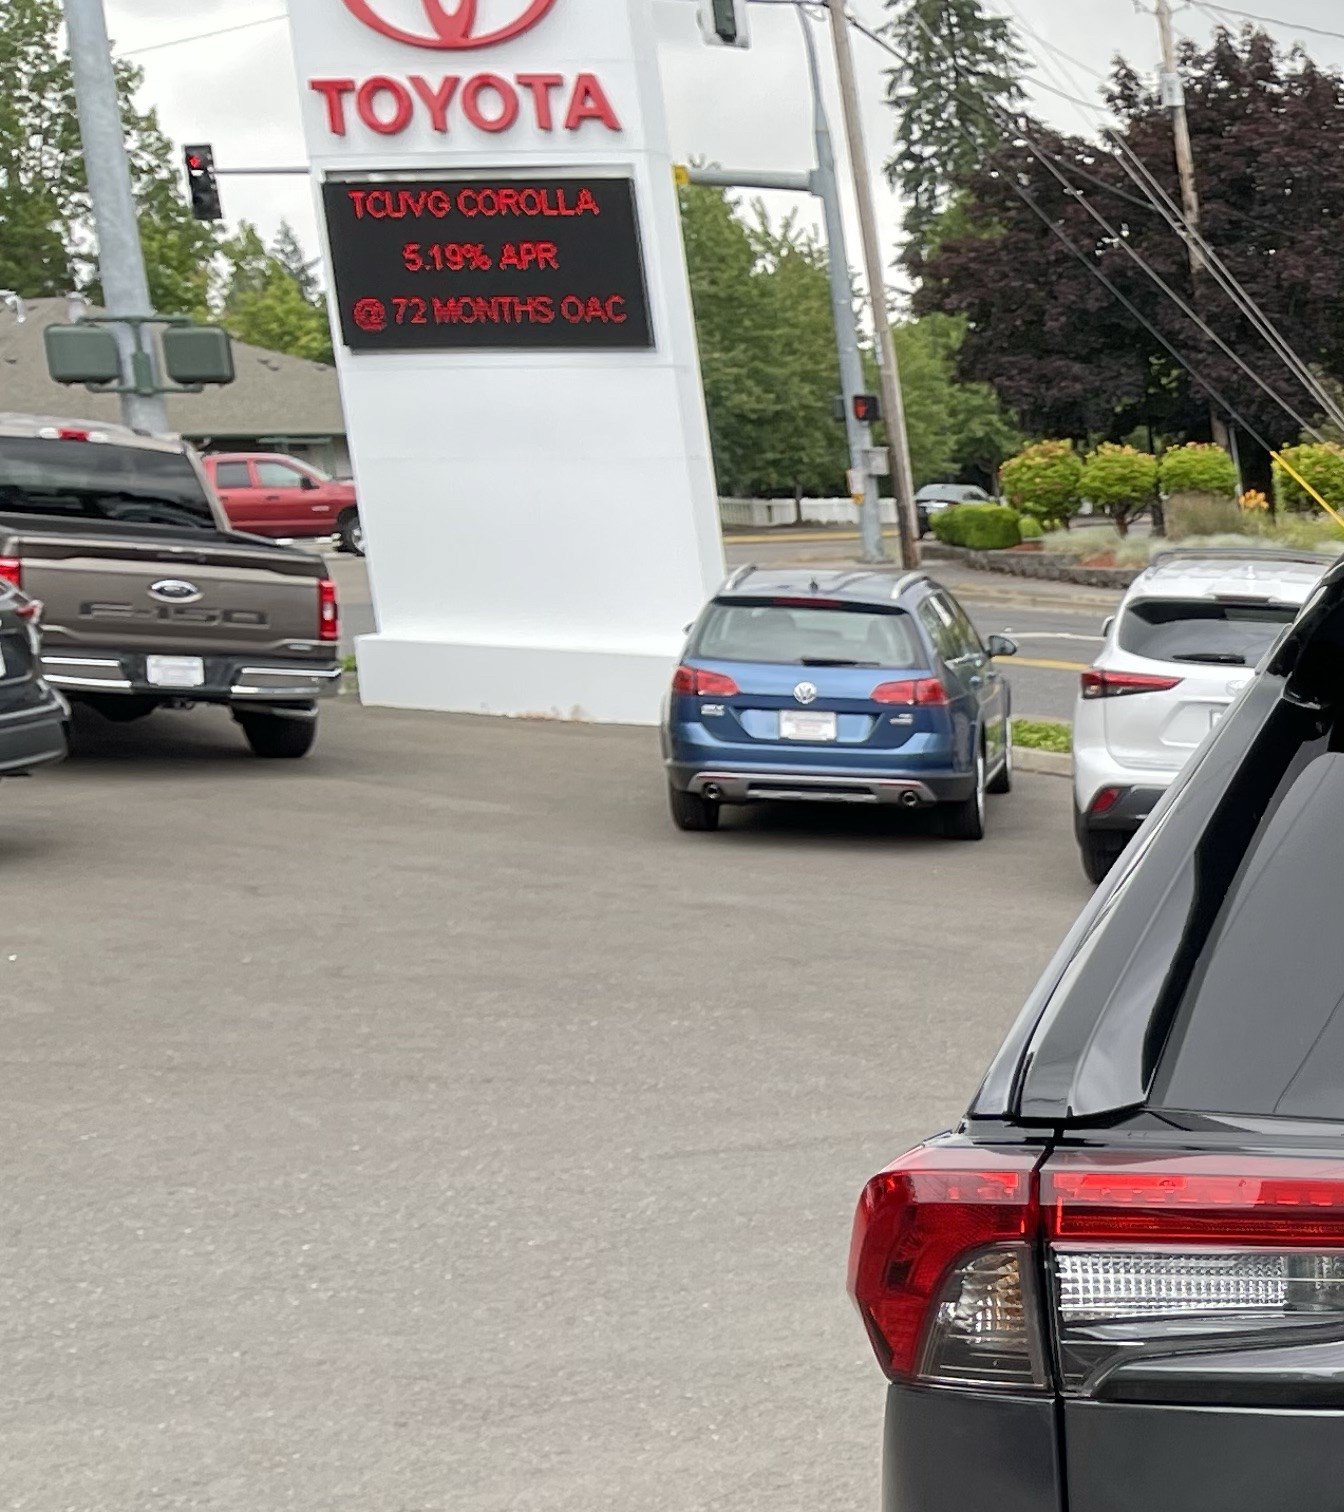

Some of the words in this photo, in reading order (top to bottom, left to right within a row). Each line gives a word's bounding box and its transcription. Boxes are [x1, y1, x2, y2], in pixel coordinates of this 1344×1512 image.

[309, 72, 622, 136] TOYOTA
[456, 188, 600, 217] COROLLA
[402, 242, 492, 271] 5.19%
[500, 240, 559, 270] APR
[391, 297, 427, 324] 72
[432, 295, 555, 324] MONTHS
[561, 294, 627, 323] OAC
